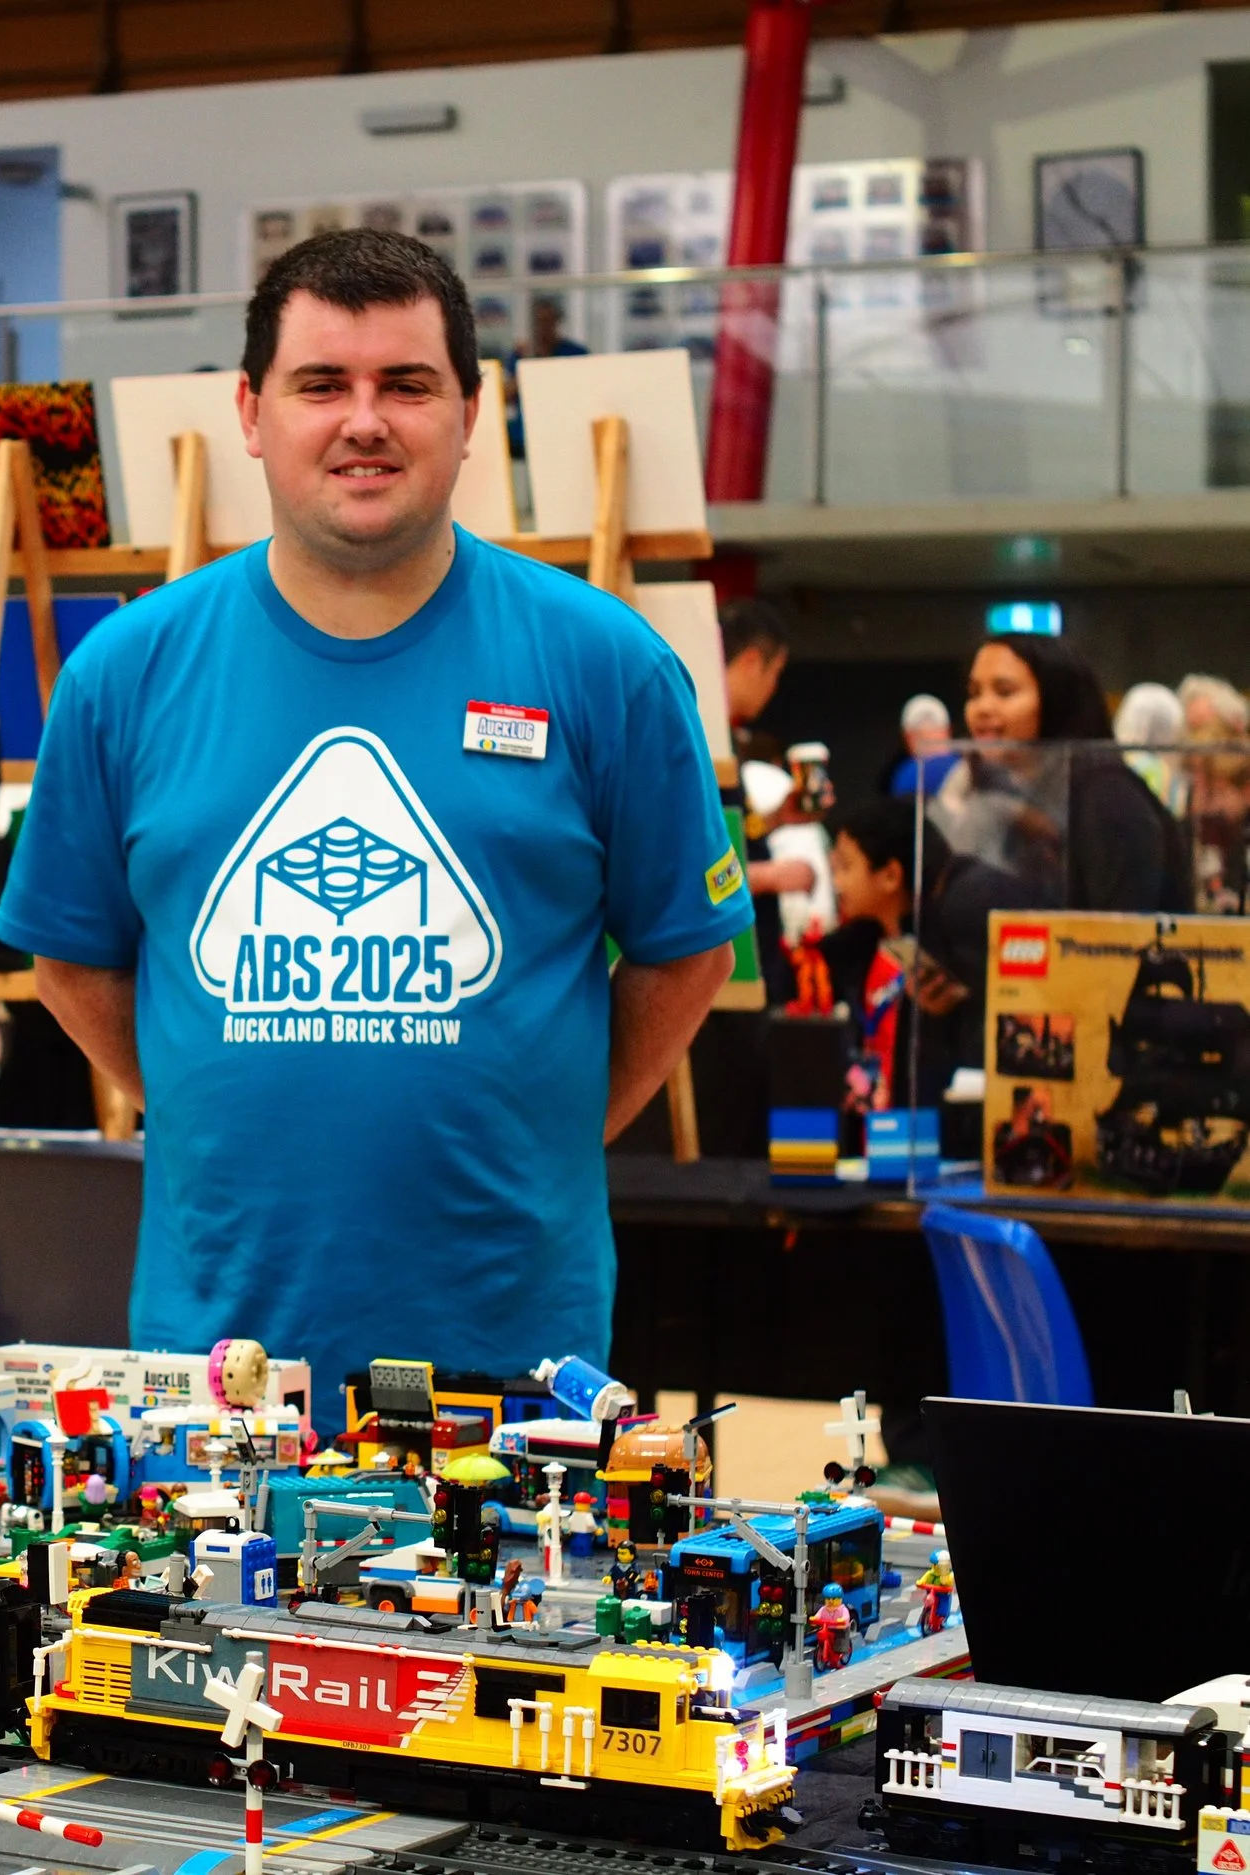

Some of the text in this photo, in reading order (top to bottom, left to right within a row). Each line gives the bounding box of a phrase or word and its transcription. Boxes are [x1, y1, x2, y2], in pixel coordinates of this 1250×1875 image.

[232, 934, 453, 1003] ABS 2025
[223, 1013, 462, 1045] AUCKLAND BRICK SHOW
[701, 1570, 724, 1579] CENTER
[602, 1729, 662, 1756] 7307
